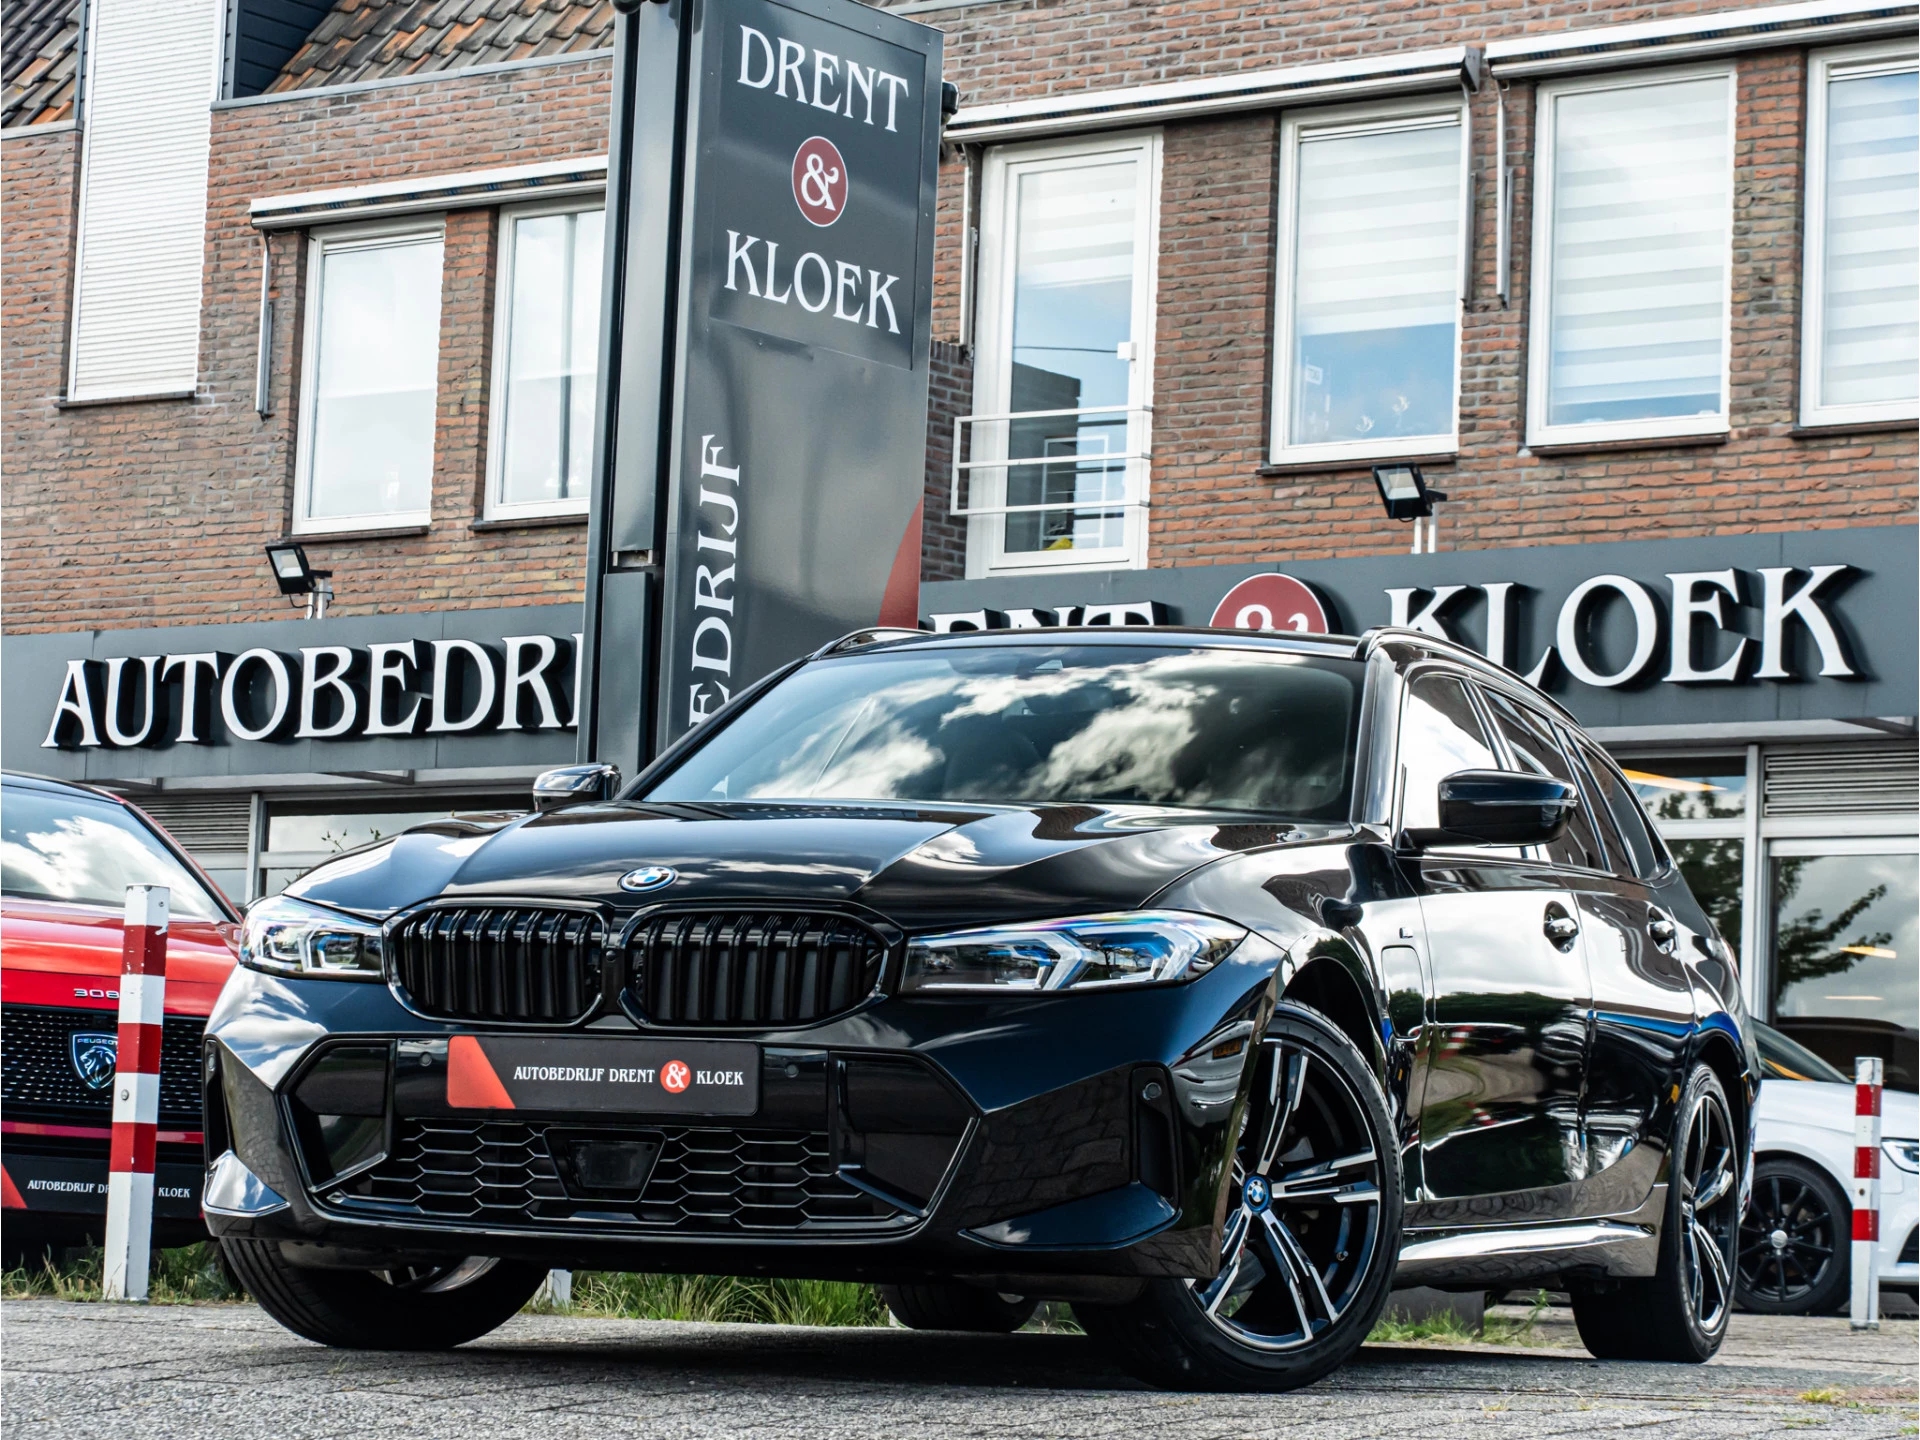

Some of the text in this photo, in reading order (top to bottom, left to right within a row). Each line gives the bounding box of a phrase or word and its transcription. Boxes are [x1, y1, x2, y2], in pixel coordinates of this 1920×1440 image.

[737, 24, 909, 133] DRENT
[800, 153, 839, 211] &
[723, 229, 901, 334] KLOEK
[73, 988, 120, 999] 308
[513, 1063, 744, 1089] AUTOBEDRIJF DRENT & KLOEK
[27, 1179, 96, 1193] AUTOBEDRIJF
[158, 1187, 191, 1198] KLOEK
